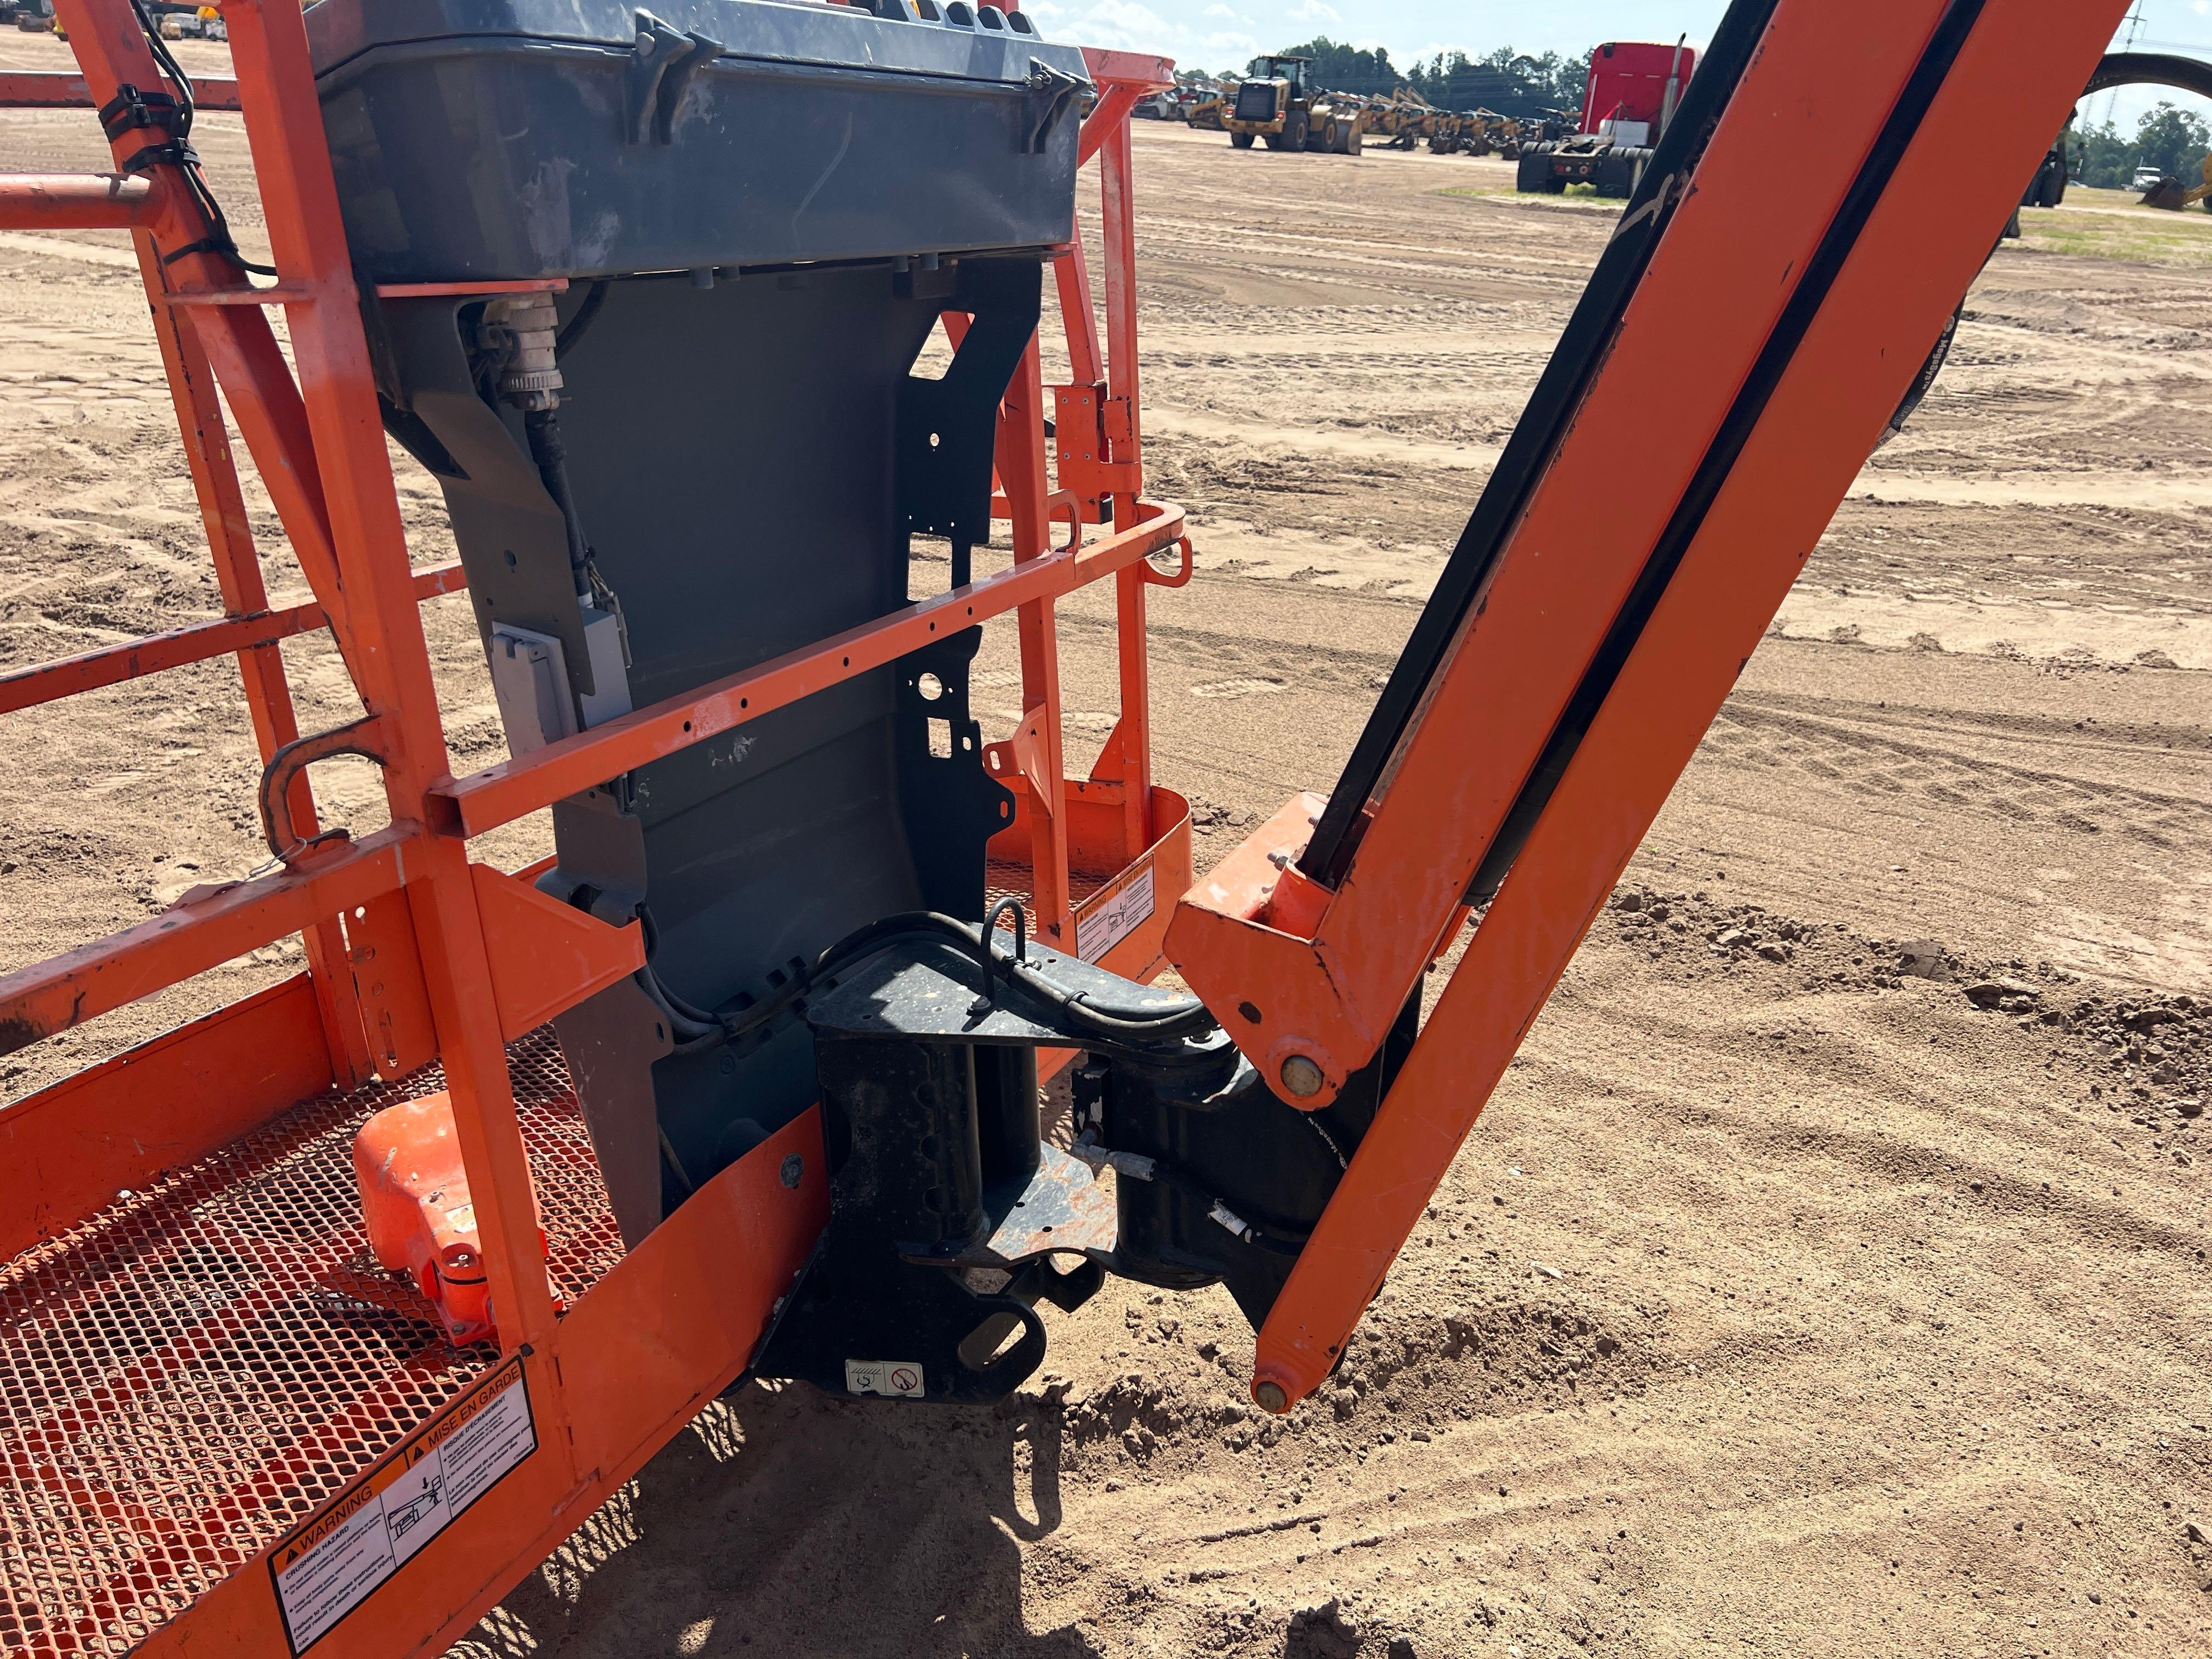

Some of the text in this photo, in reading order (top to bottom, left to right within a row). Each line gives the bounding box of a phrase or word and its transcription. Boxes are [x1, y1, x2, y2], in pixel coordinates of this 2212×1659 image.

[1084, 895, 1106, 917] WARNING
[428, 1415, 458, 1448] MISE
[460, 1400, 477, 1421] EN
[479, 1365, 520, 1405] GARDE
[444, 1430, 465, 1452] RISQUE
[300, 1486, 373, 1550] WARNING
[286, 1526, 349, 1580] CRUSHING HAZARD
[298, 1637, 309, 1647] CAN
